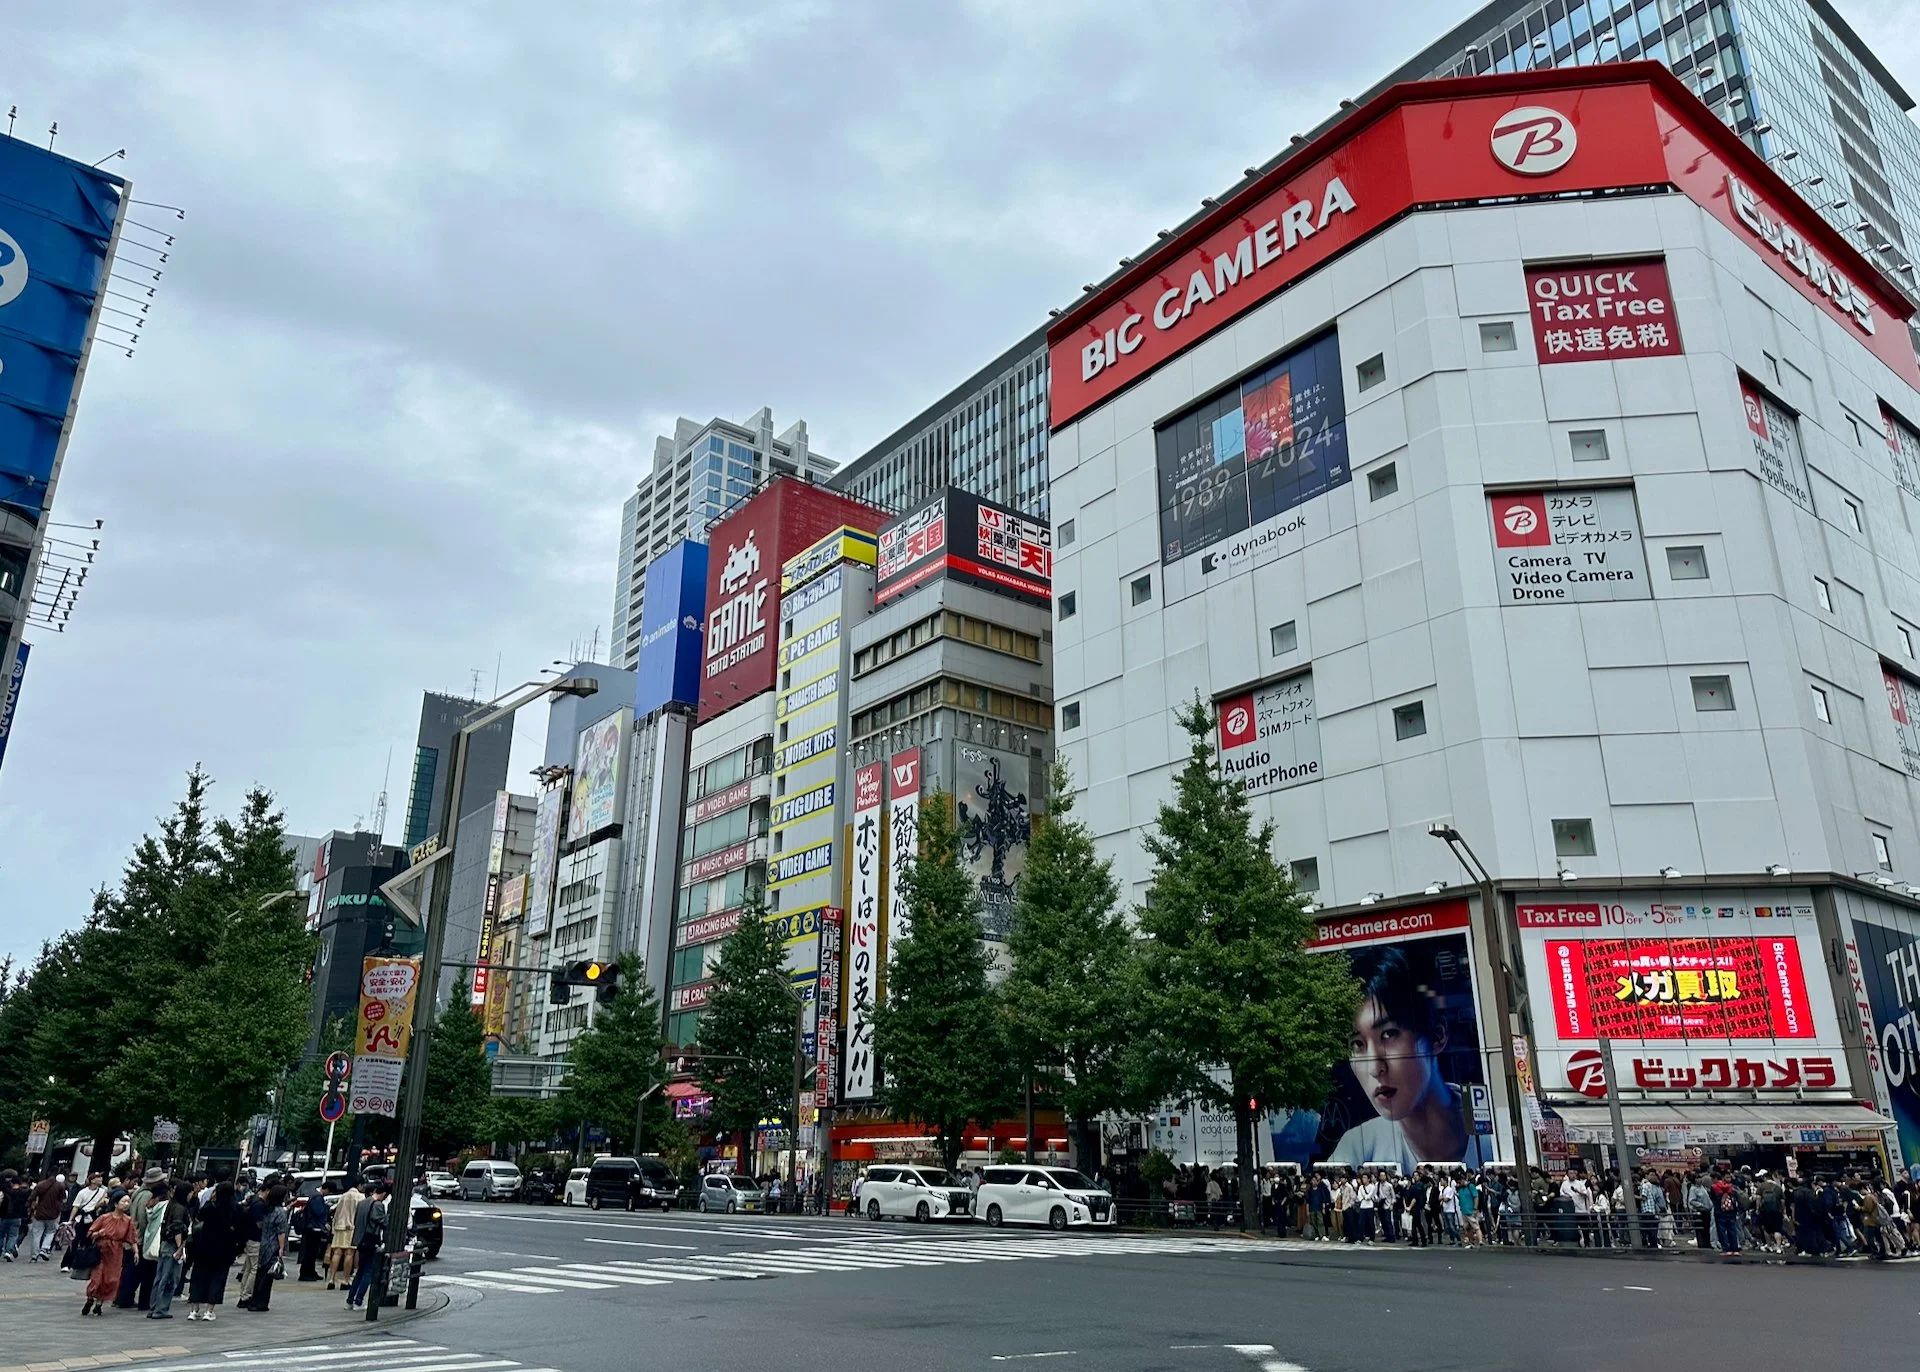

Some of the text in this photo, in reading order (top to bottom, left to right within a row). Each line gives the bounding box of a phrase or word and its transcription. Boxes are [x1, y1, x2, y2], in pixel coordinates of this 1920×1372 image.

[1082, 176, 1357, 383] BIC CAMERA
[1534, 271, 1639, 301] QUICK
[1536, 296, 1665, 322] Tax Free
[1543, 322, 1669, 354] 快速免税
[1260, 415, 1333, 480] 2024
[1753, 439, 1785, 472] Home
[1168, 468, 1231, 521] 1989
[1760, 459, 1807, 503] Appliance
[1550, 496, 1593, 510] カメラ
[1552, 513, 1597, 528] テレビ
[1231, 516, 1307, 557] dynabook
[1554, 530, 1633, 546] ビデオカメラ
[978, 541, 1018, 563] ホビー
[1508, 552, 1607, 569] Camera TV
[978, 566, 995, 579] VOLKS
[1511, 568, 1634, 586] Video Camera
[1513, 586, 1565, 601] Drone
[706, 578, 768, 660] GAME
[730, 633, 765, 666] STATION
[790, 619, 838, 661] PC GAME
[1257, 682, 1303, 706] オーディオ
[1258, 698, 1313, 722] スマートフォン
[1260, 714, 1312, 739] SIMカード
[784, 728, 835, 767] MODEL KITS
[1224, 750, 1271, 775] Audio
[1244, 760, 1318, 791] artPhone
[707, 786, 748, 809] VIDEO GAME
[782, 785, 833, 822] FIGURE
[701, 848, 744, 873] MUSIC GAME
[779, 844, 831, 880] VIDEO GAME
[694, 913, 740, 936] RACING GAME
[1318, 912, 1433, 941] BicCamera.com
[1523, 908, 1596, 924] Tax Free
[1602, 904, 1625, 925] 10
[1626, 916, 1644, 925] OFF
[1650, 904, 1665, 924] 5
[1666, 916, 1683, 924] OFF
[1614, 969, 1742, 1000] メガ買取
[1772, 942, 1799, 1034] BicCamera.com
[1845, 939, 1879, 1073] Tax Free
[1632, 1057, 1837, 1088] ビックカメラ
[1473, 1088, 1485, 1107] P
[1200, 1125, 1222, 1137] edge
[1223, 1125, 1232, 1134] 60
